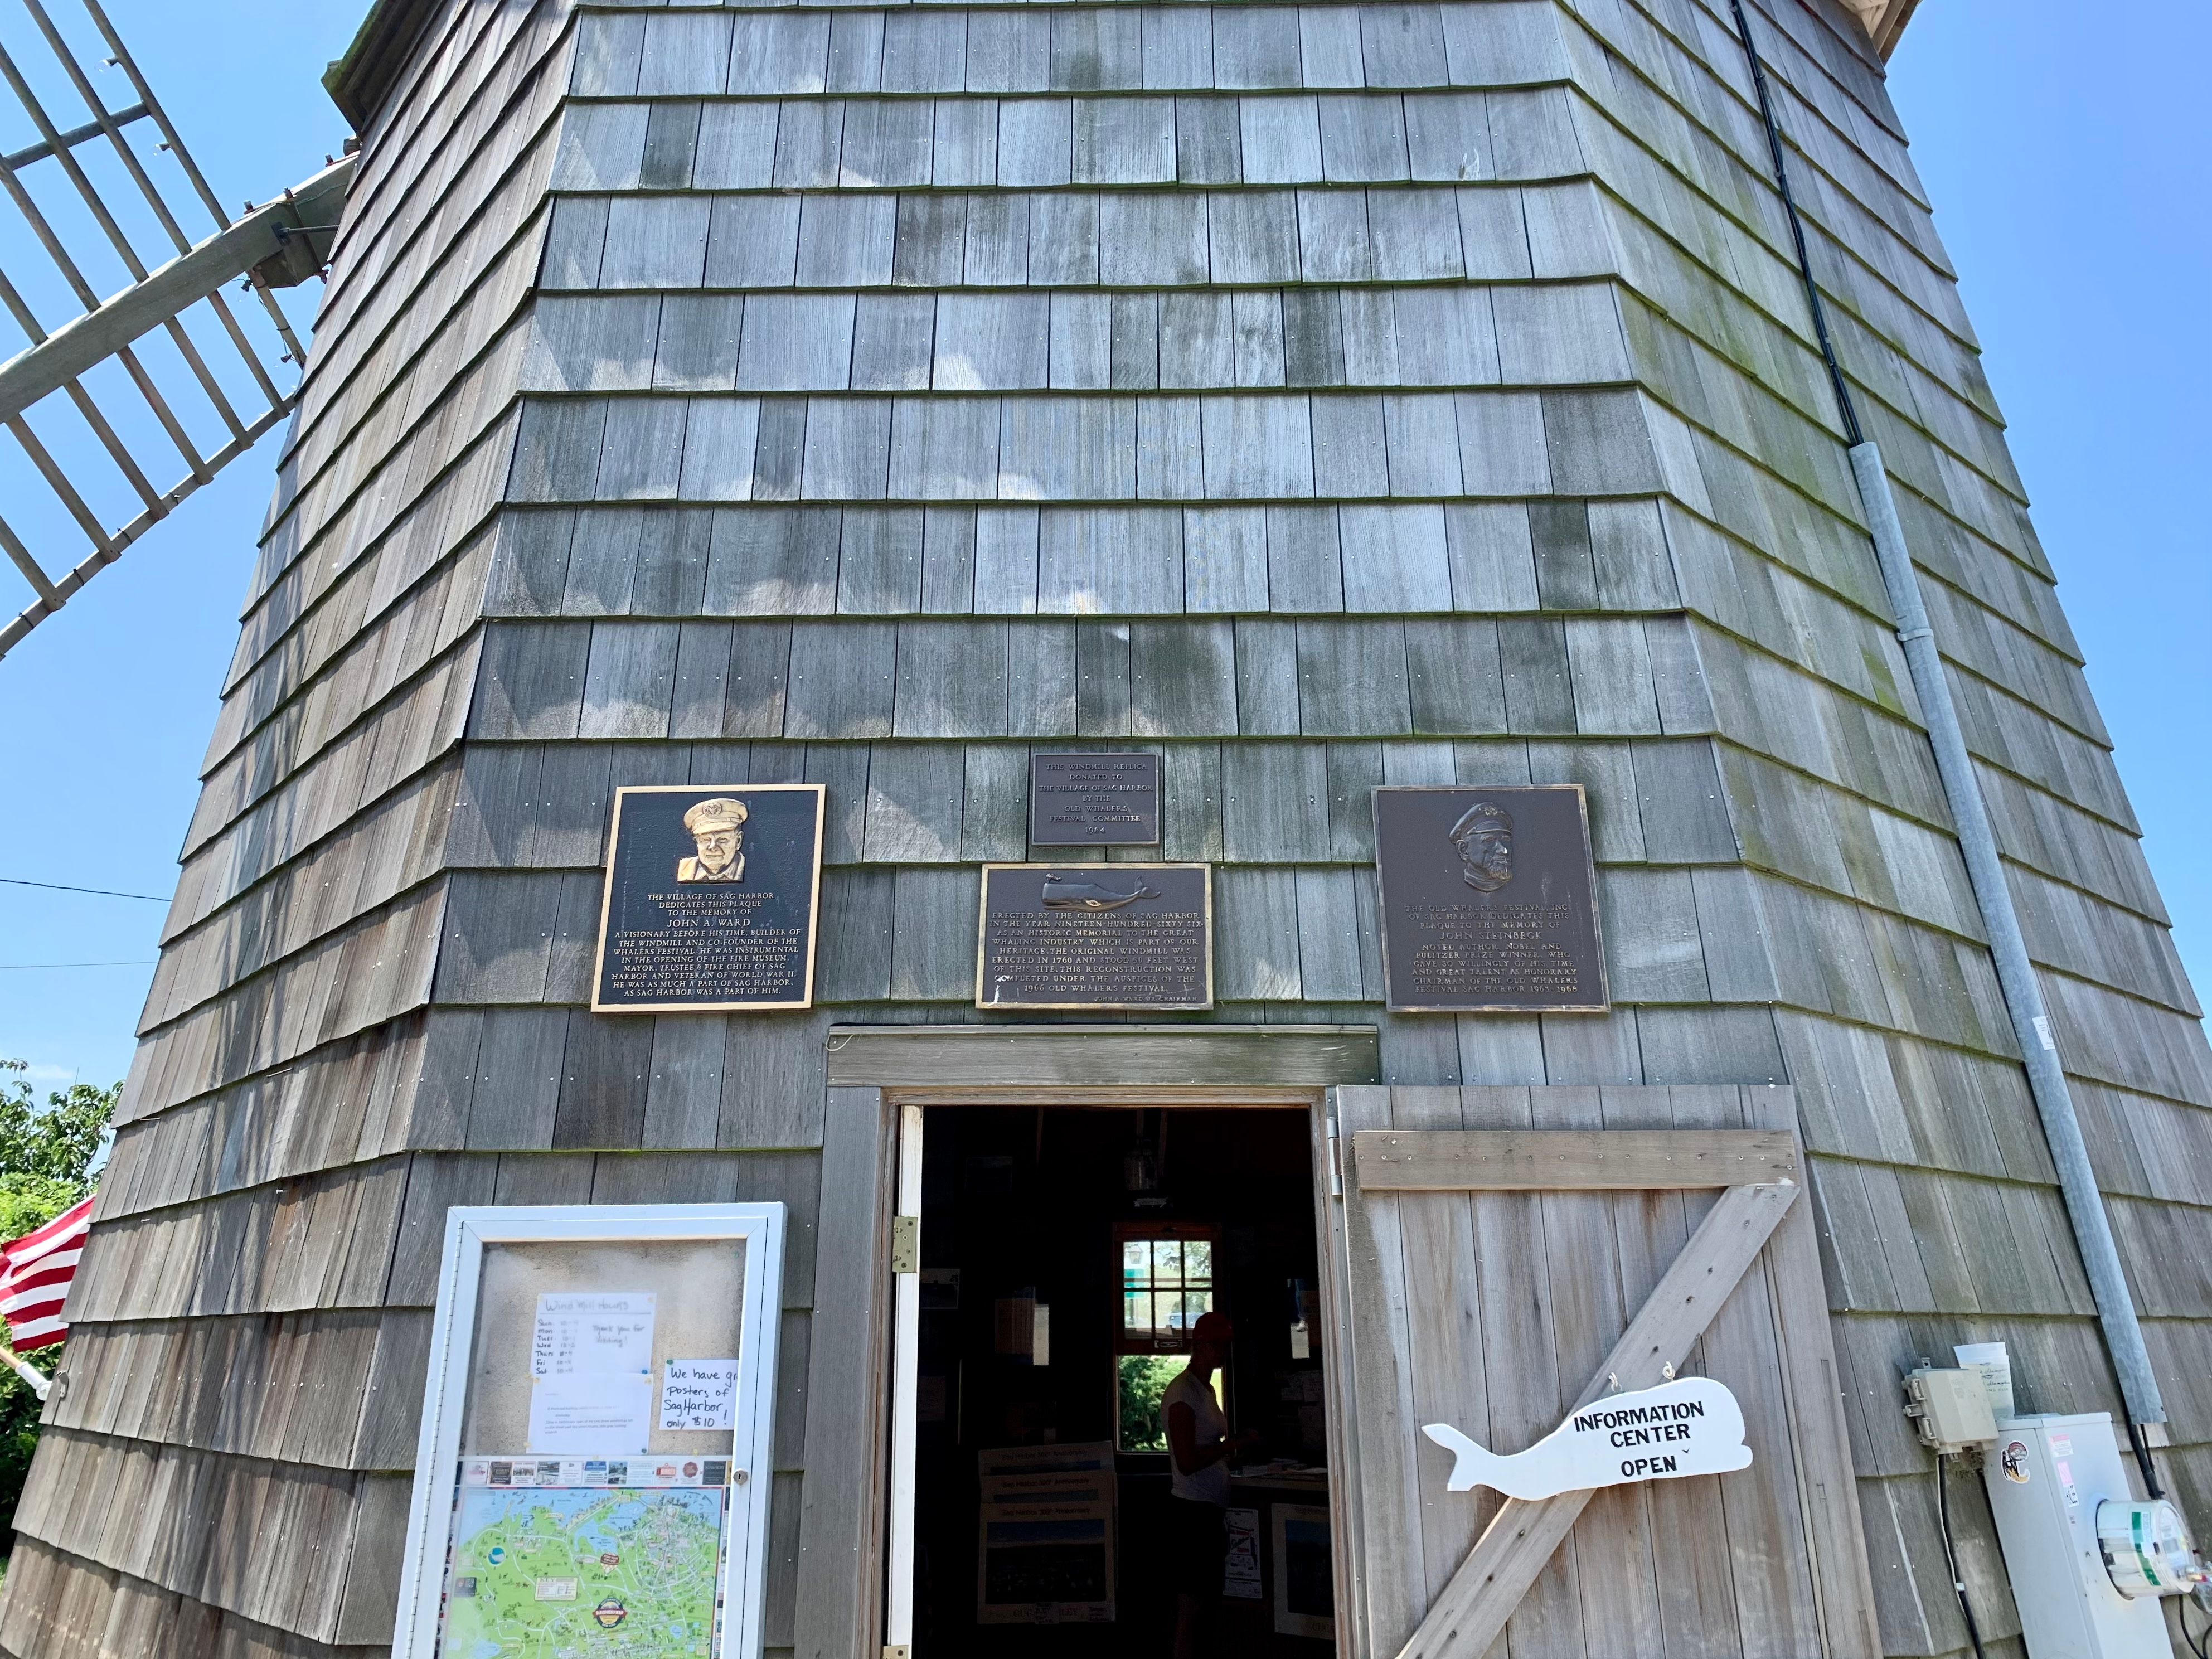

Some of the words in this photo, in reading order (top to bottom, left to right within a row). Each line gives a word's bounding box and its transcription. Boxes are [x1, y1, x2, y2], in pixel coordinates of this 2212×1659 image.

[667, 919, 698, 928] JOHN
[671, 1367, 687, 1379] We
[693, 1369, 720, 1379] have
[716, 1388, 729, 1397] of
[1574, 1401, 1704, 1432] INFORMATION
[667, 1419, 686, 1429] only
[1610, 1423, 1691, 1448] CENTER
[1621, 1455, 1677, 1477] OPEN
